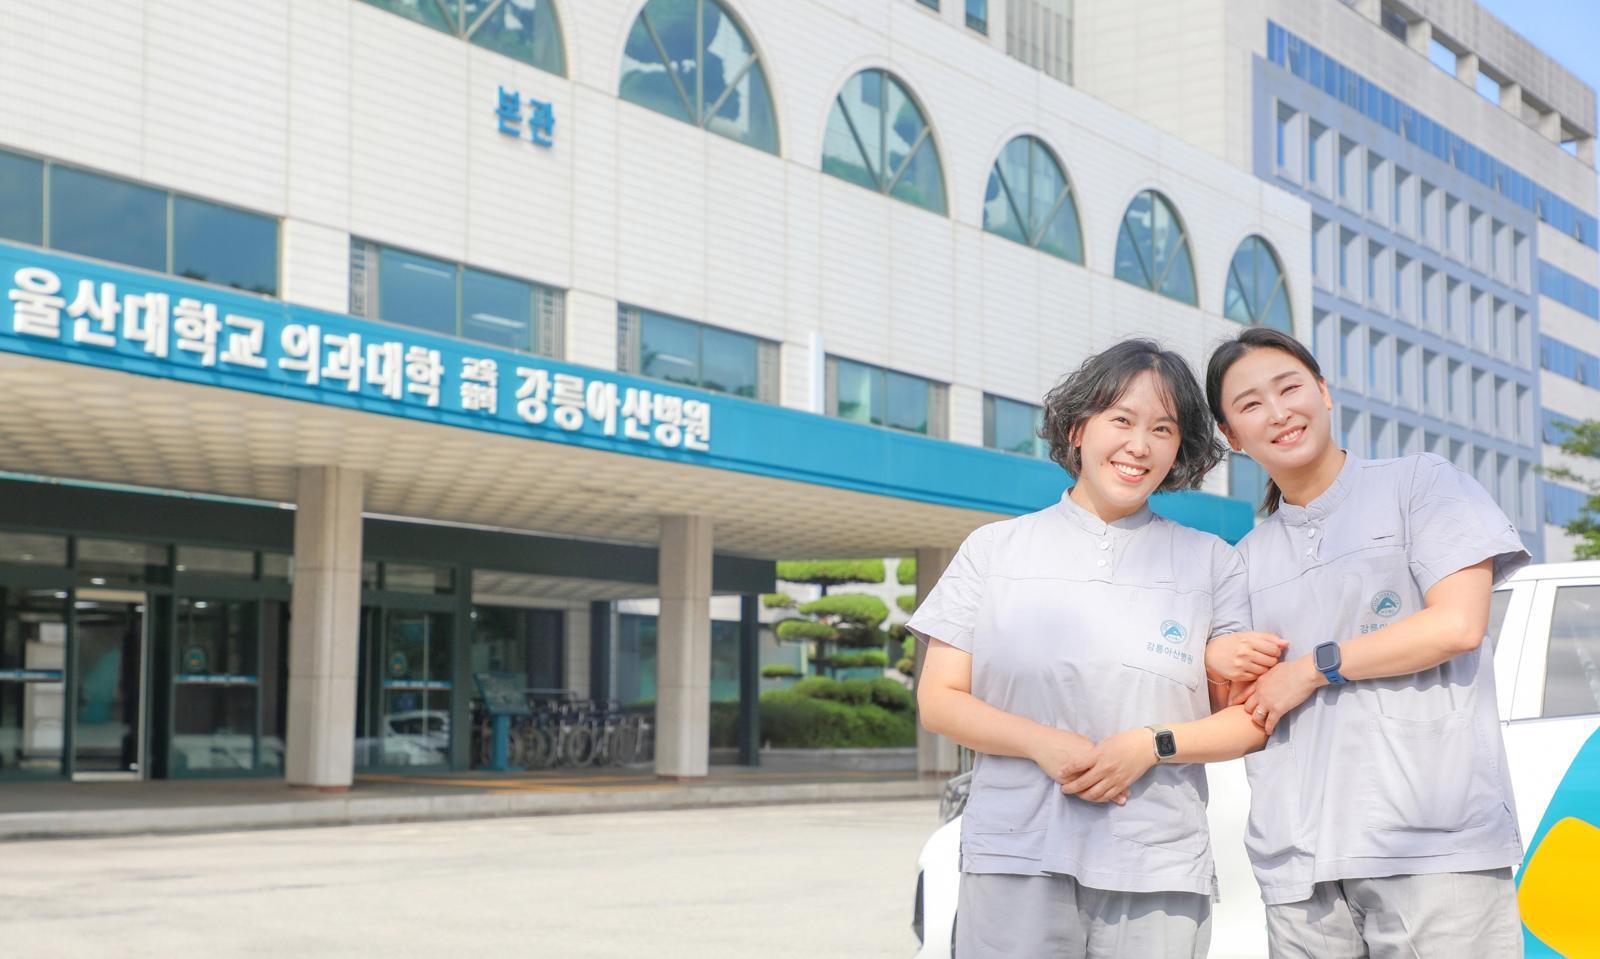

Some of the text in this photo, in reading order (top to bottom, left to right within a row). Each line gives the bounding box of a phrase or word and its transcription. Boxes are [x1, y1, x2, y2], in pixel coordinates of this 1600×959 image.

[495, 86, 555, 147] 본관
[8, 267, 268, 369] 울산대학교
[278, 323, 445, 407] 의과대학
[515, 366, 711, 451] 강릉아산병원
[1145, 640, 1194, 665] 강릉아산병원
